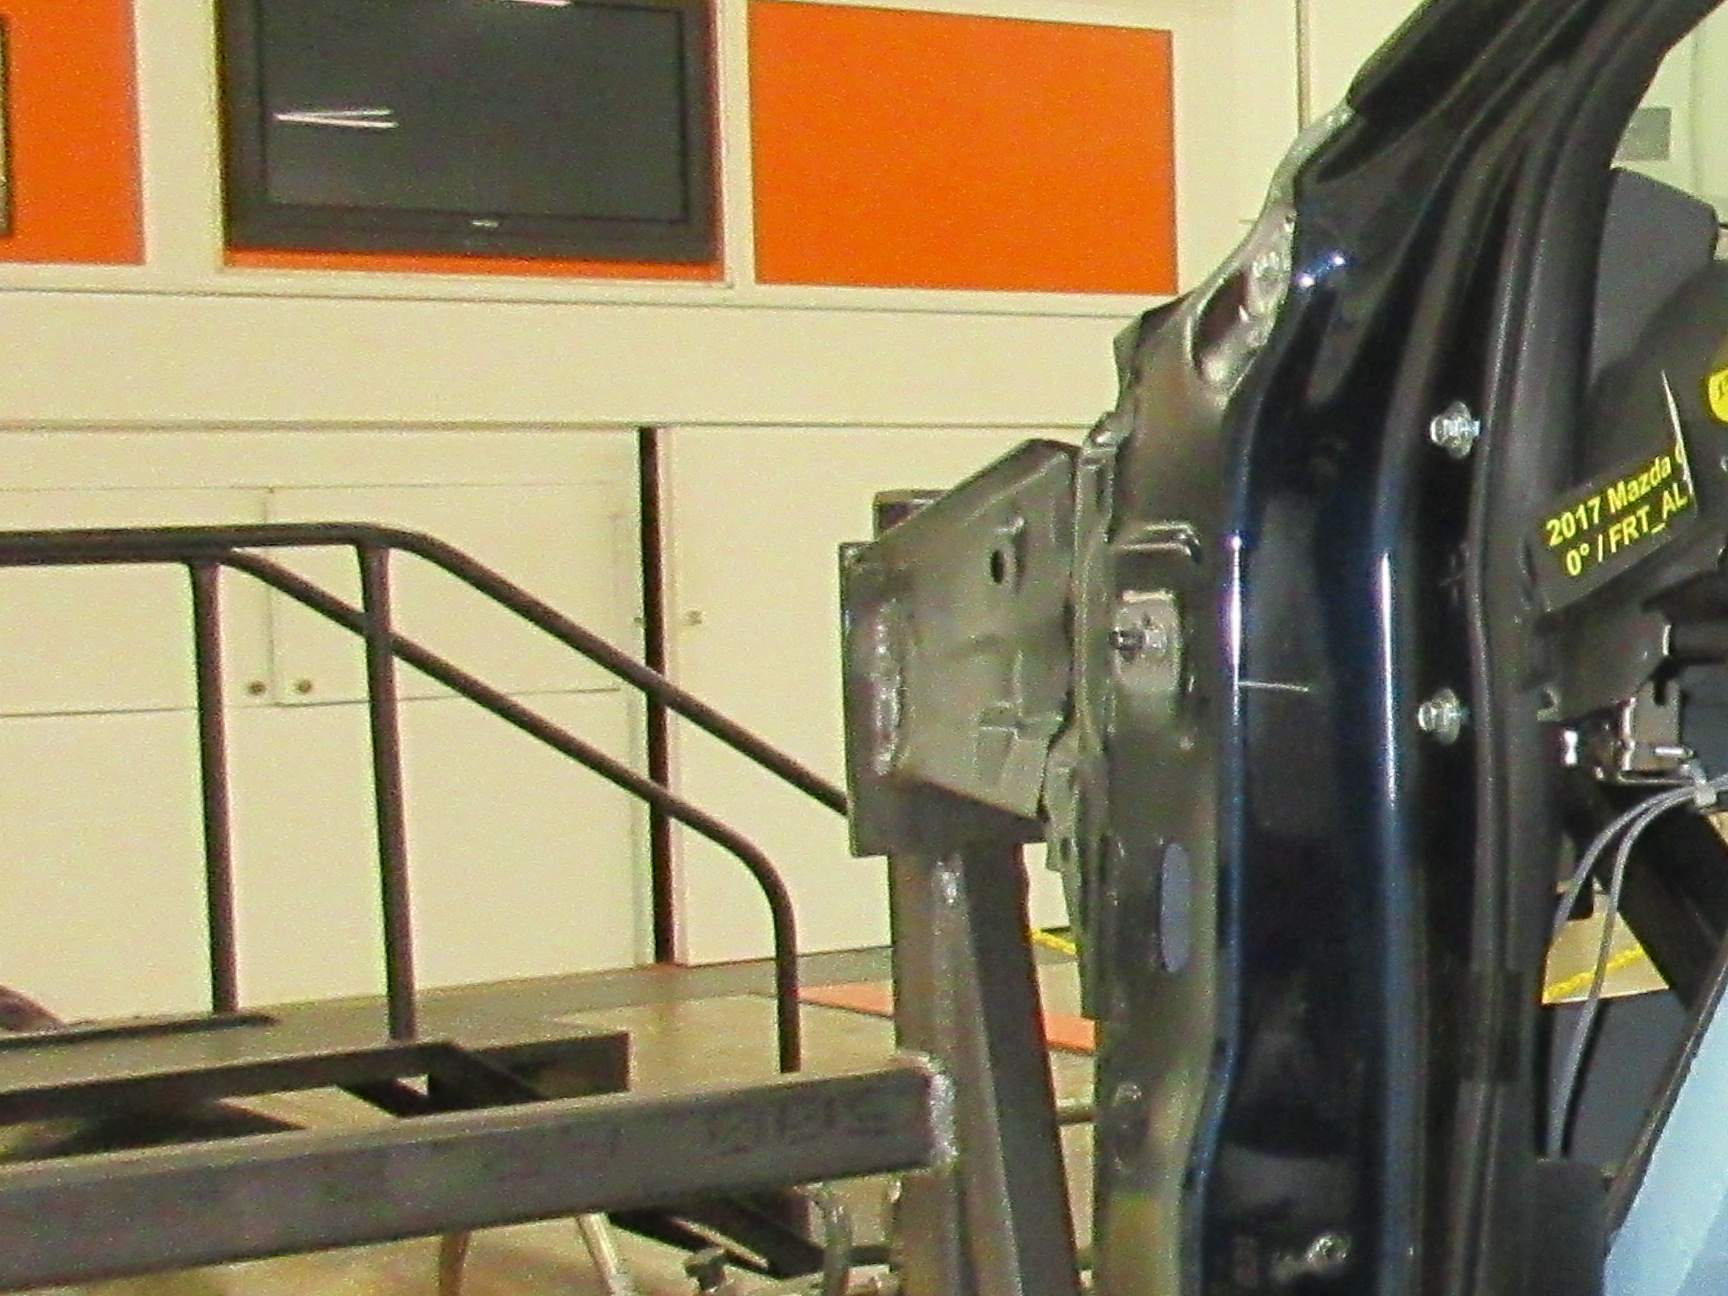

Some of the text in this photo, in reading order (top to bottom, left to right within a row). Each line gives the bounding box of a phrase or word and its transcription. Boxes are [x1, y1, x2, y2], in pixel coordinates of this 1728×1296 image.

[1545, 495, 1602, 548] 2017
[1606, 455, 1672, 515] Mazda
[1608, 482, 1692, 554] FRT_AL
